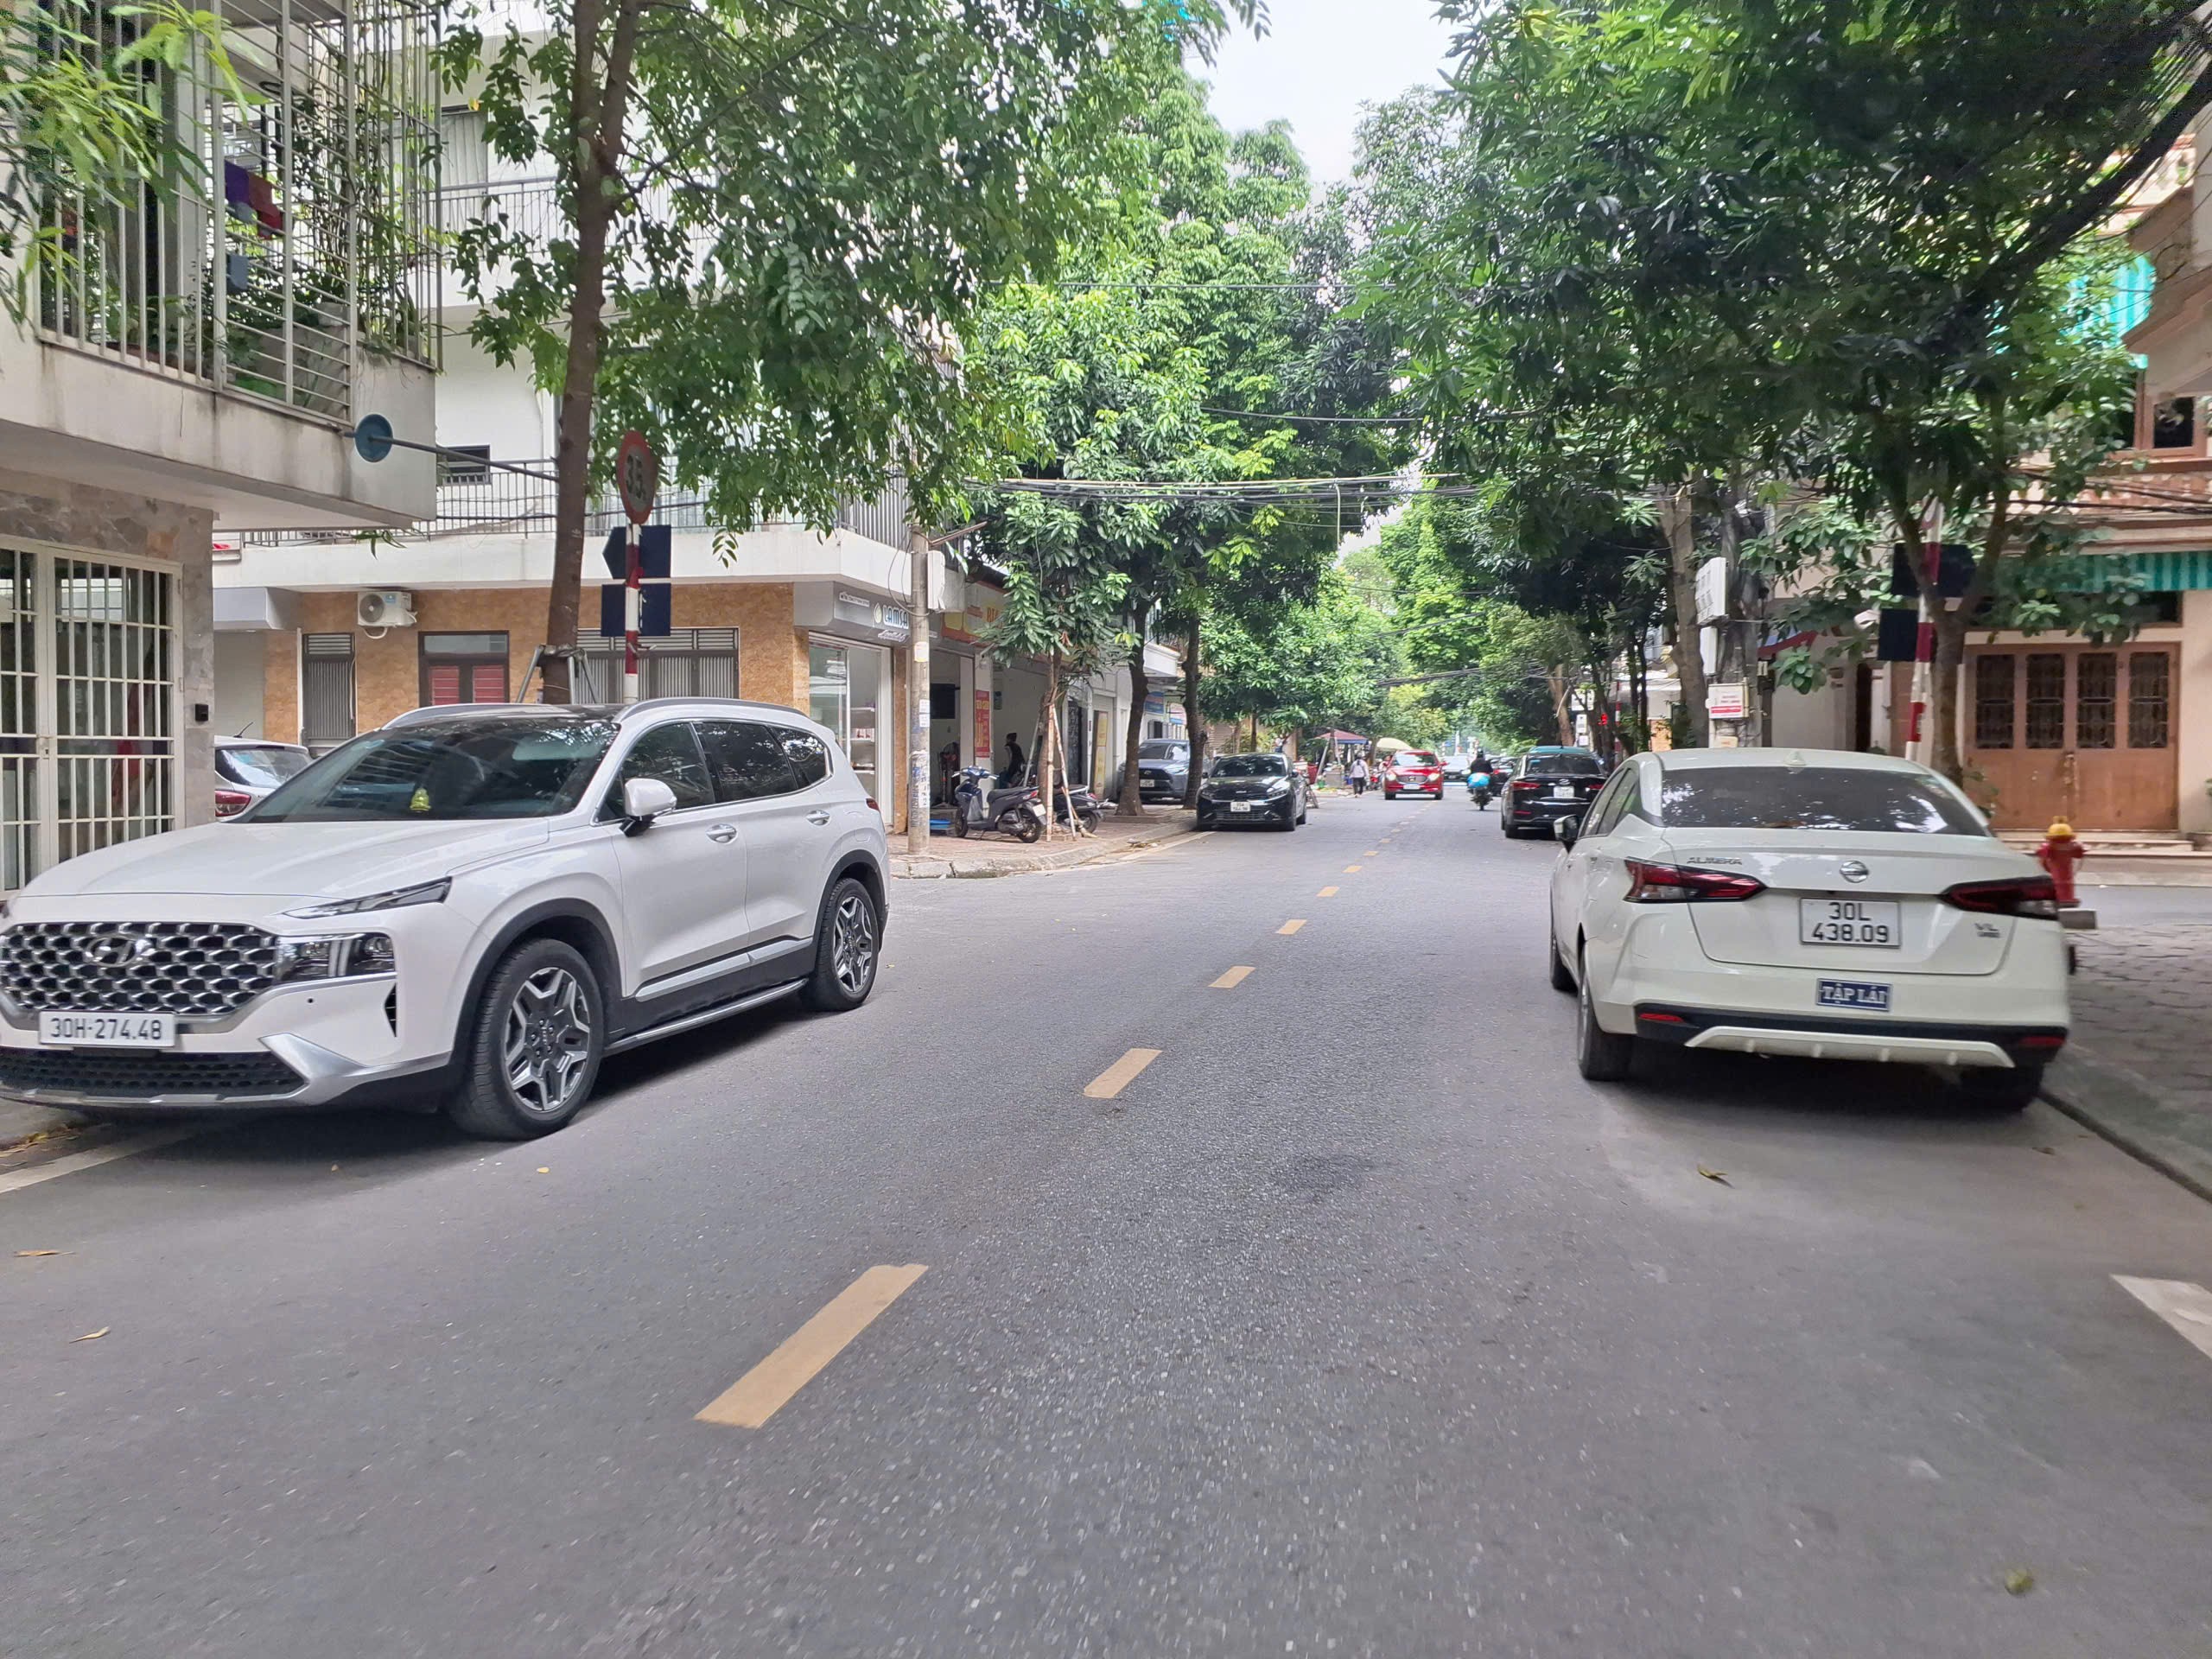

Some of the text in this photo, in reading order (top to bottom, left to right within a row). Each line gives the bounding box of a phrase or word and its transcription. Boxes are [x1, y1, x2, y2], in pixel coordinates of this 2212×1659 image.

[1828, 901, 1872, 921] 30L
[1811, 922, 1889, 944] 438.09
[50, 1017, 162, 1040] 30H-274.48
